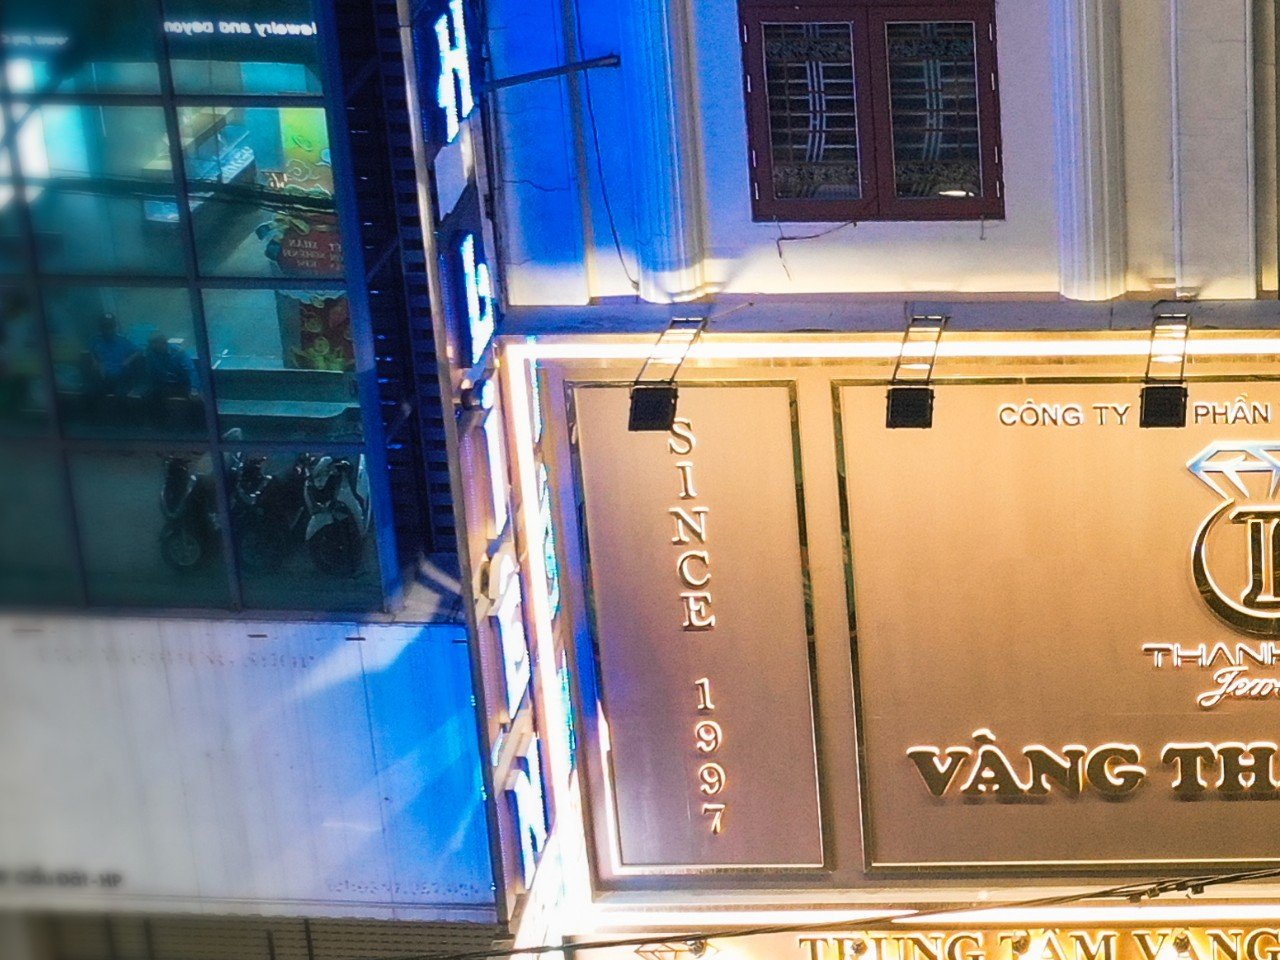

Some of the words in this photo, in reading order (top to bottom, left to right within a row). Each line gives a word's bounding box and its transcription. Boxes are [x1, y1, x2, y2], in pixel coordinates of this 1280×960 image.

[998, 398, 1083, 427] CÔNG
[1092, 403, 1131, 426] TY
[1194, 392, 1272, 425] PHẦN
[905, 727, 1147, 798] VÀNG
